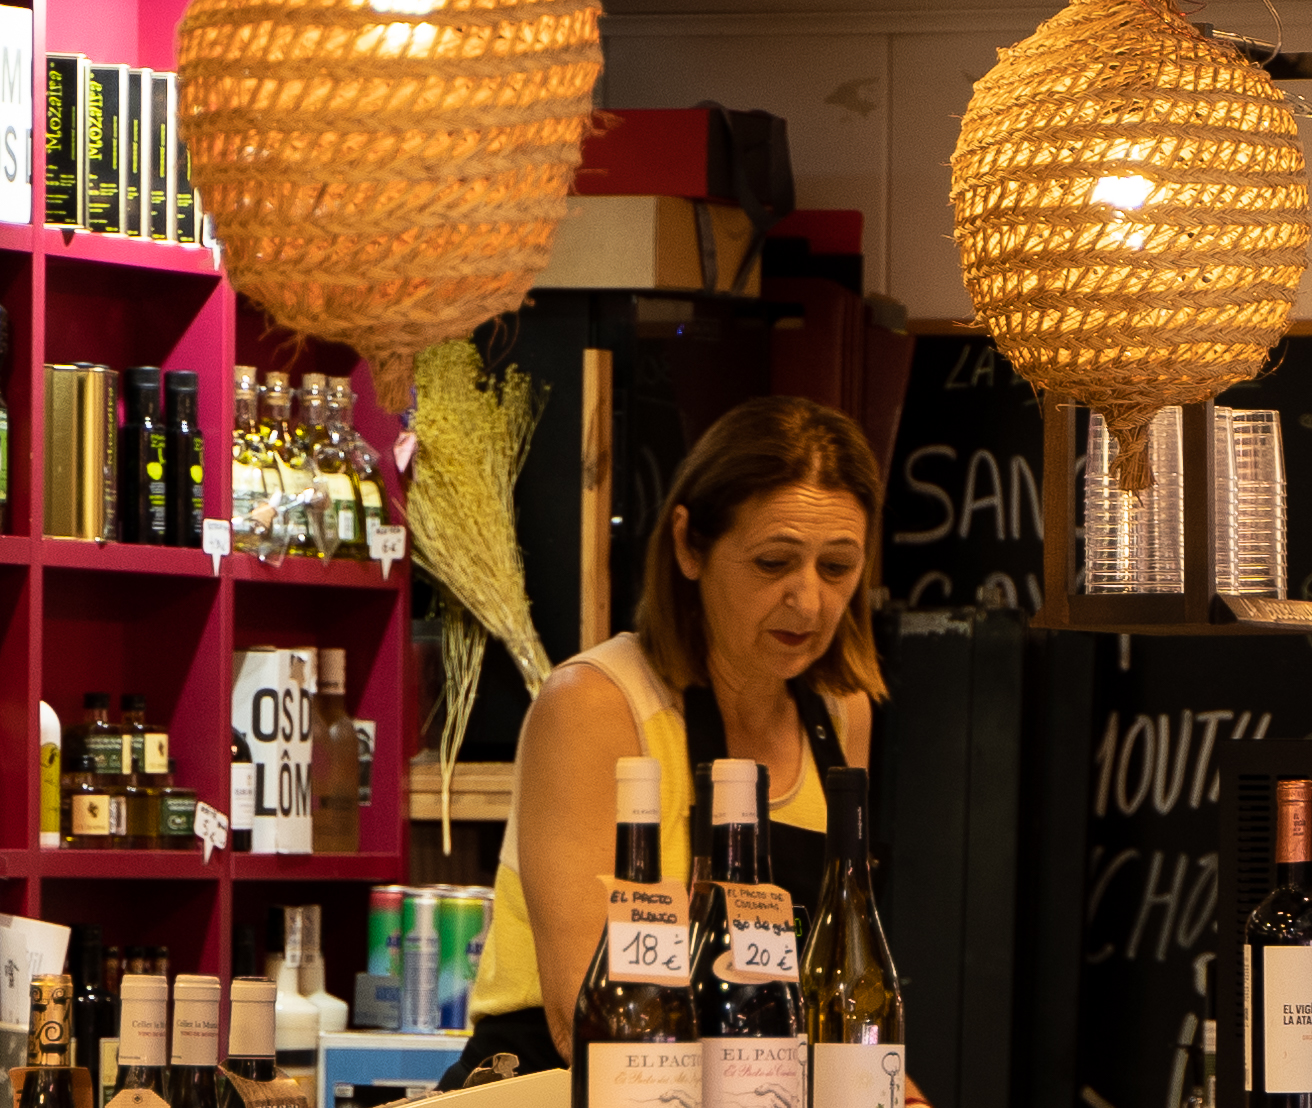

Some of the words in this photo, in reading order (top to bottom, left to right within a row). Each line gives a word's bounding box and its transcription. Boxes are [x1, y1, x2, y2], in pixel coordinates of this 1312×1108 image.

[611, 890, 628, 903] EL
[633, 891, 673, 905] PACTO
[727, 889, 737, 898] EL
[739, 890, 767, 900] PACTO
[623, 931, 658, 965] 18
[746, 943, 770, 966] 20
[1283, 1005, 1294, 1014] EL
[1283, 1016, 1294, 1025] LA
[722, 1048, 747, 1061] EL
[626, 1055, 654, 1068] EL
